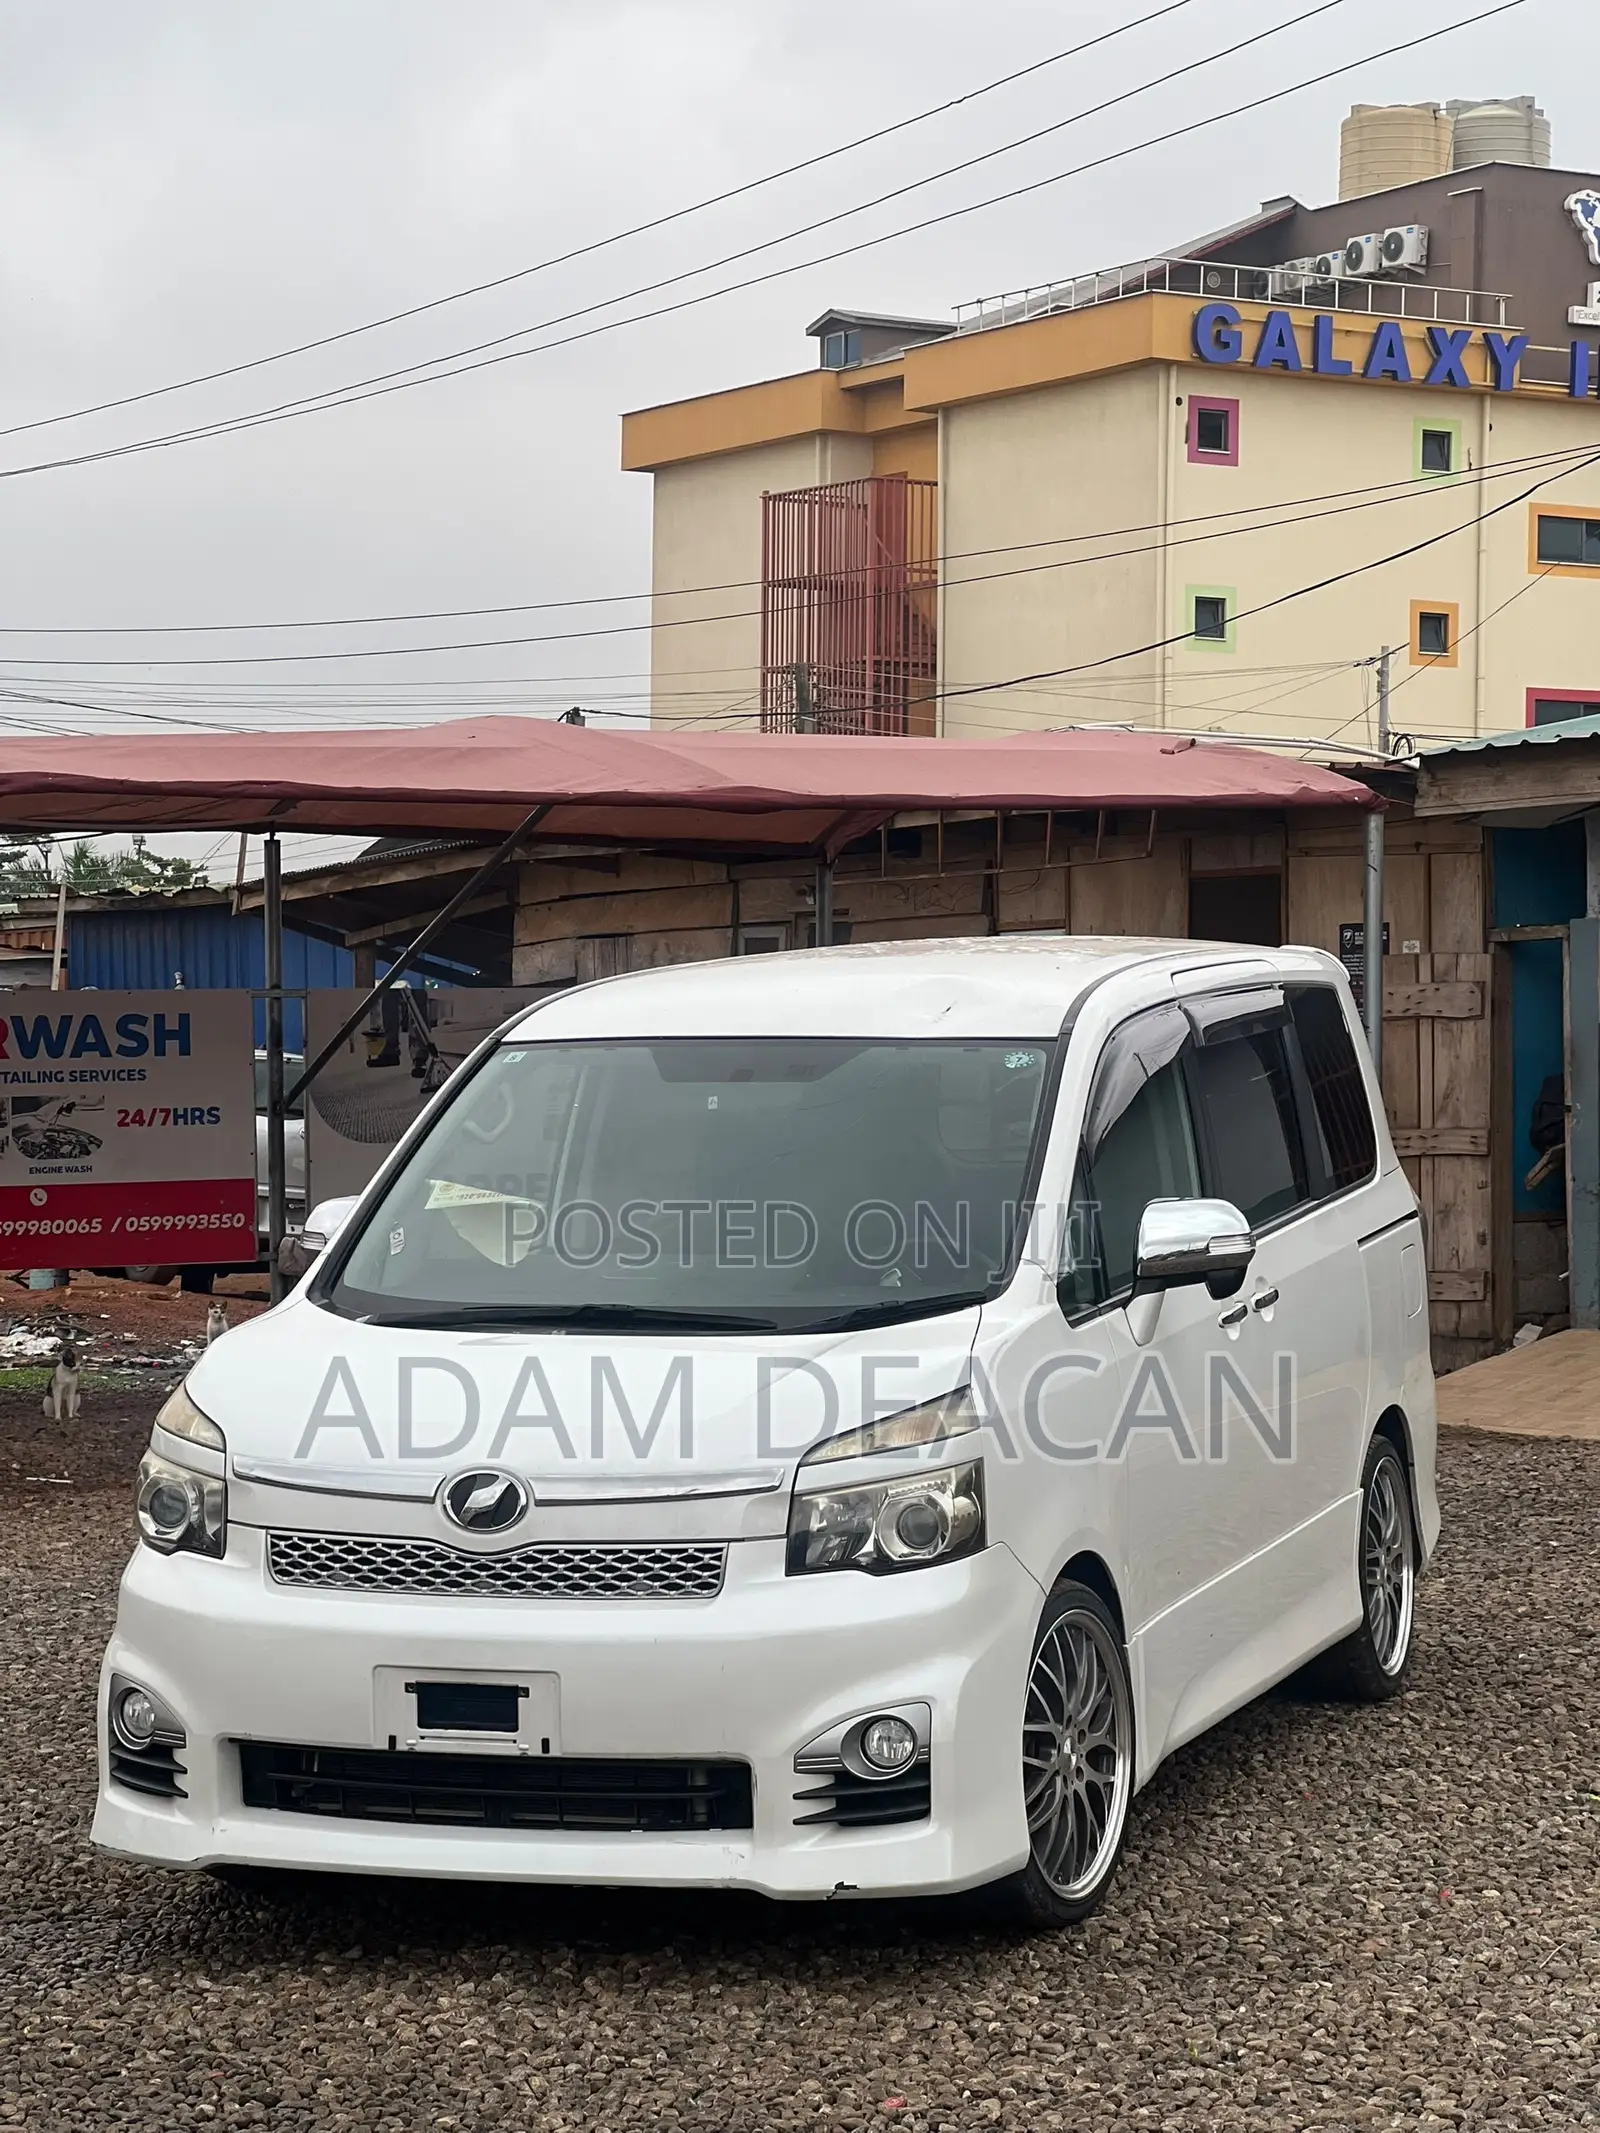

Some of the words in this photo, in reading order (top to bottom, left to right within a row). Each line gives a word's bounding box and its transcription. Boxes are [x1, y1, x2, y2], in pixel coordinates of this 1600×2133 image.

[1193, 303, 1529, 392] GALAXY
[1570, 340, 1600, 398] I
[68, 1068, 147, 1083] SERVICES
[116, 1106, 221, 1128] 24/7HRS
[29, 1166, 63, 1175] ENGINE
[65, 1165, 93, 1174] WASH
[125, 1213, 245, 1232] 0599993550
